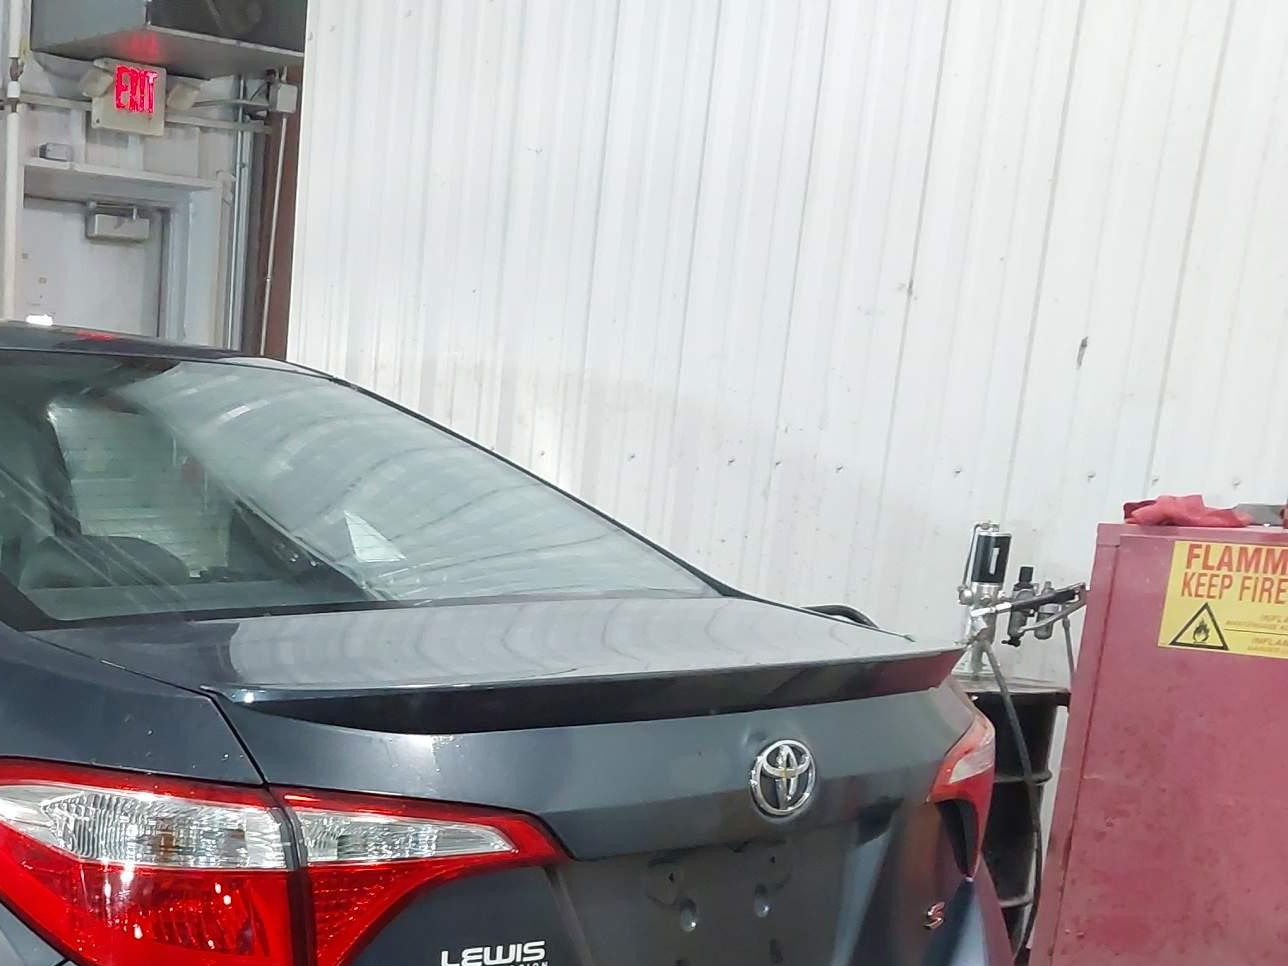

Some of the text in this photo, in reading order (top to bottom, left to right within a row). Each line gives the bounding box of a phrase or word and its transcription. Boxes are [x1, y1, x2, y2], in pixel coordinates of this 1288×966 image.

[115, 64, 158, 113] EXIT
[1181, 571, 1288, 605] KEEP FIRE
[925, 901, 945, 929] S
